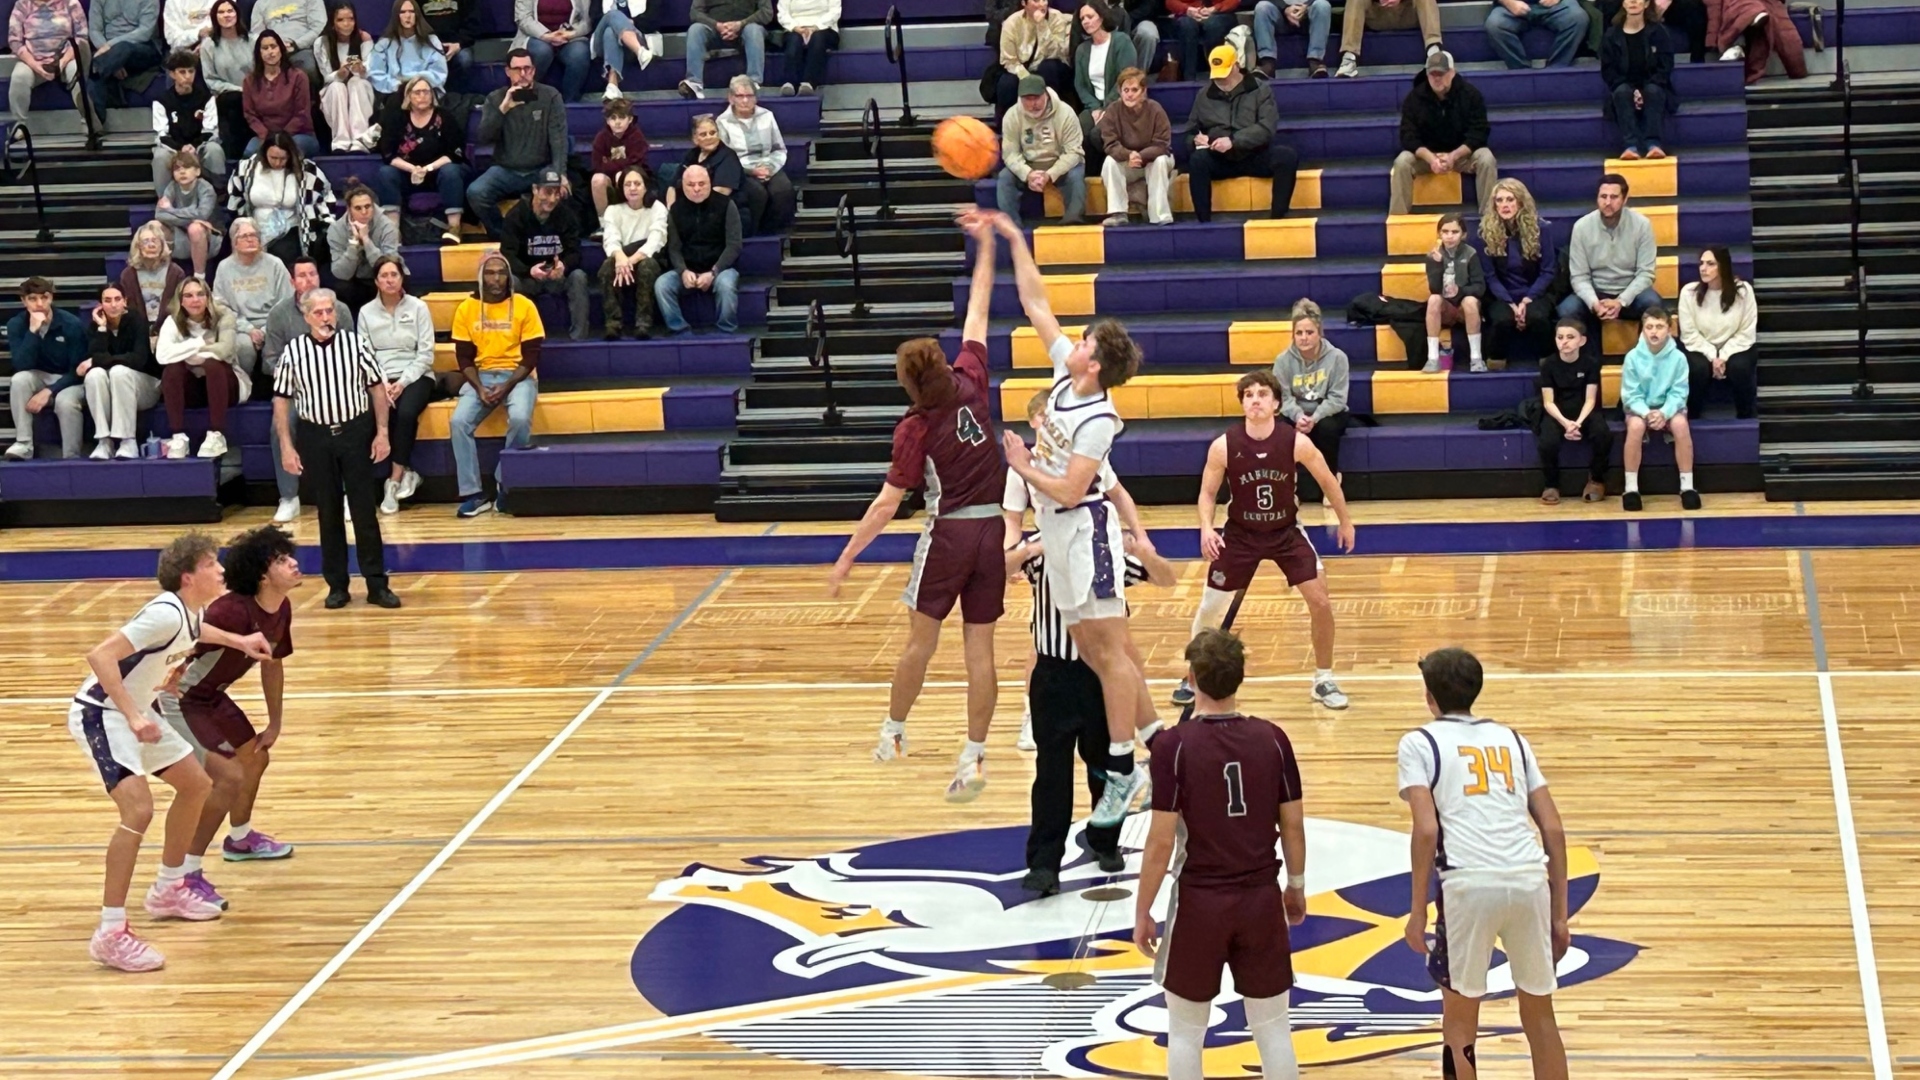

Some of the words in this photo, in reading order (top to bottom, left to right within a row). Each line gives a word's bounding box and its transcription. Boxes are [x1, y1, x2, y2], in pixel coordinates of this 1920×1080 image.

[957, 405, 987, 447] 4
[1256, 484, 1274, 511] 5
[1223, 761, 1247, 817] 1
[1457, 745, 1516, 797] 34
